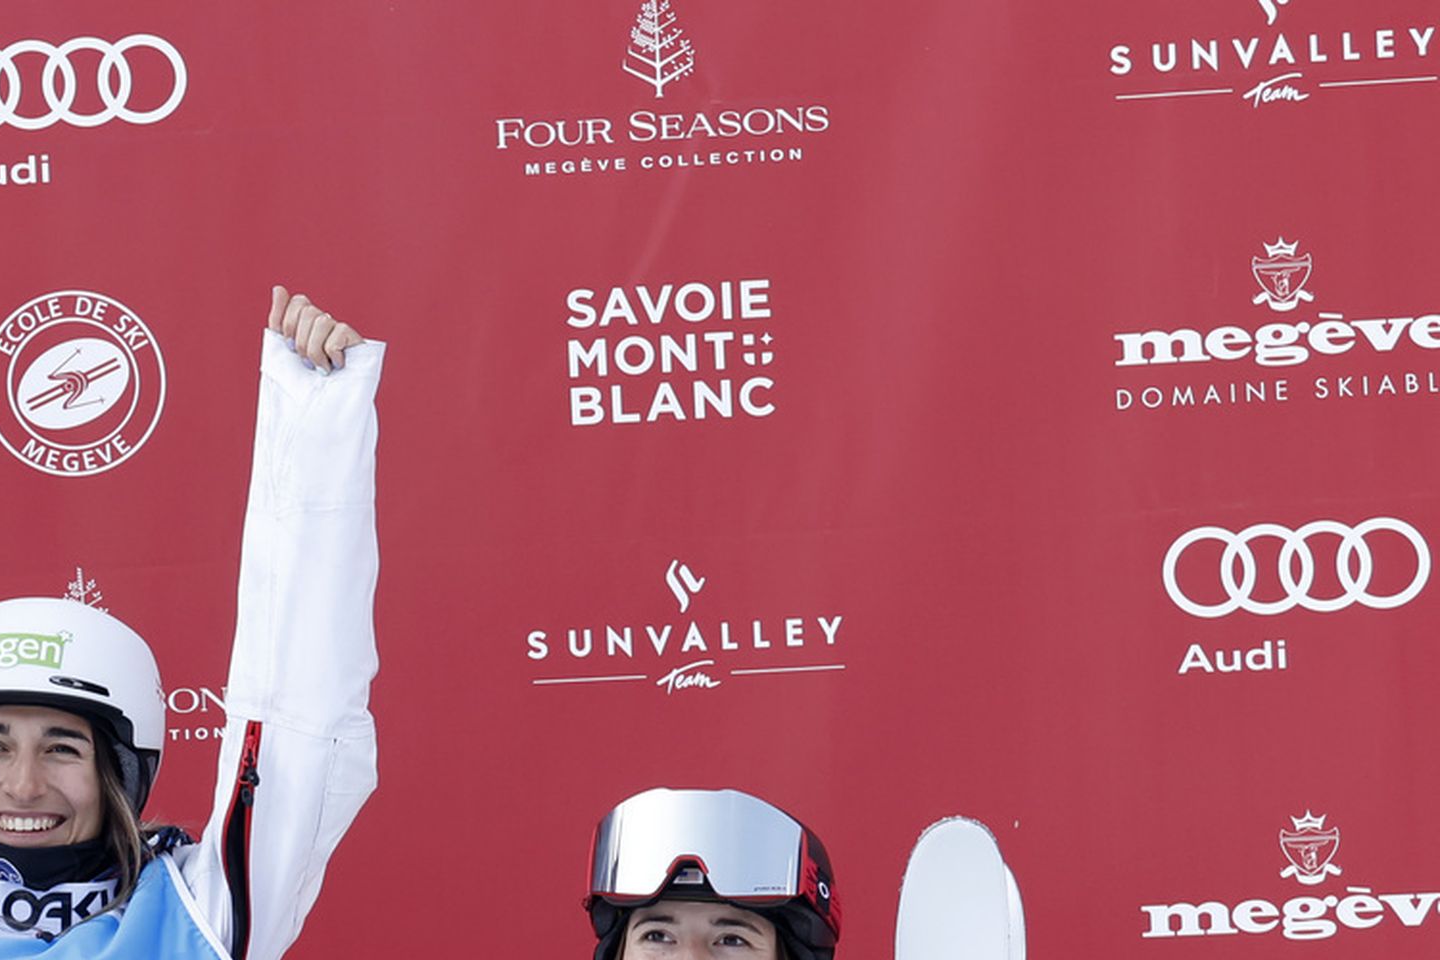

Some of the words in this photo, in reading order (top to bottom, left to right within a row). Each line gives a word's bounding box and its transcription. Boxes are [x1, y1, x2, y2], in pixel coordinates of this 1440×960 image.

[1110, 27, 1436, 75] SUNVALLEY
[1243, 73, 1309, 108] Team
[496, 118, 614, 149] FOUR
[628, 105, 830, 142] SEASONS
[524, 156, 627, 176] MEGÈVE
[641, 148, 803, 169] COLLECTION
[74, 296, 109, 321] DE
[112, 314, 150, 351] SKI
[567, 279, 772, 329] SAVOIE
[568, 331, 735, 378] MONT
[570, 376, 776, 426] BLANC
[1116, 380, 1289, 410] DOMAINE
[21, 434, 132, 473] MEGEVE
[527, 615, 843, 660] SUNVALLEY
[1178, 639, 1288, 675] Audi
[656, 660, 721, 695] Team
[1140, 886, 1440, 940] megèv
